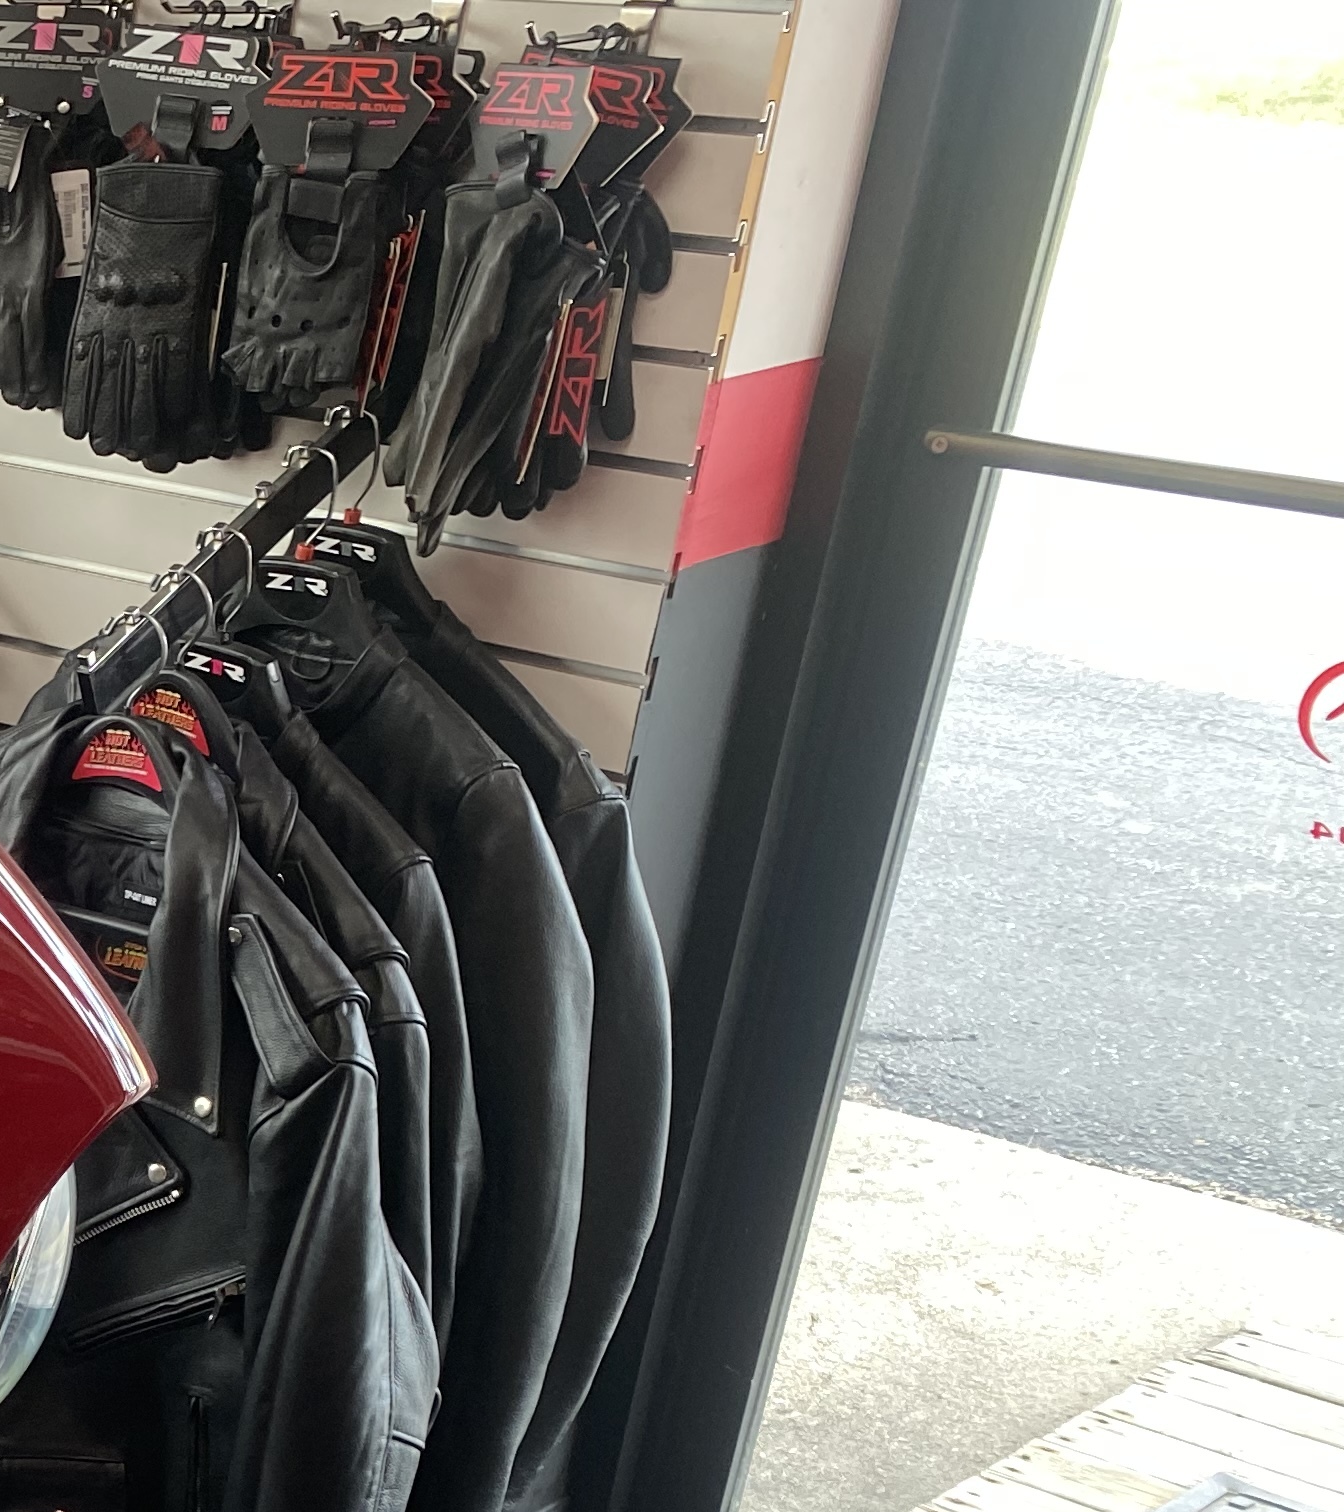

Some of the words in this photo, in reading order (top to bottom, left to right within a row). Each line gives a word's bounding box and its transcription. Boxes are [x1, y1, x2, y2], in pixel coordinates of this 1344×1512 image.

[122, 28, 247, 70] Z1R
[108, 59, 166, 73] PREMIUM
[168, 66, 207, 79] RIDING
[209, 71, 258, 85] GLOVES
[267, 54, 404, 100] Z1R
[264, 97, 317, 109] PREMIUM
[320, 101, 356, 111] RIDING
[359, 101, 406, 113] GLOVES
[483, 71, 574, 117] Z1R
[212, 115, 228, 131] M
